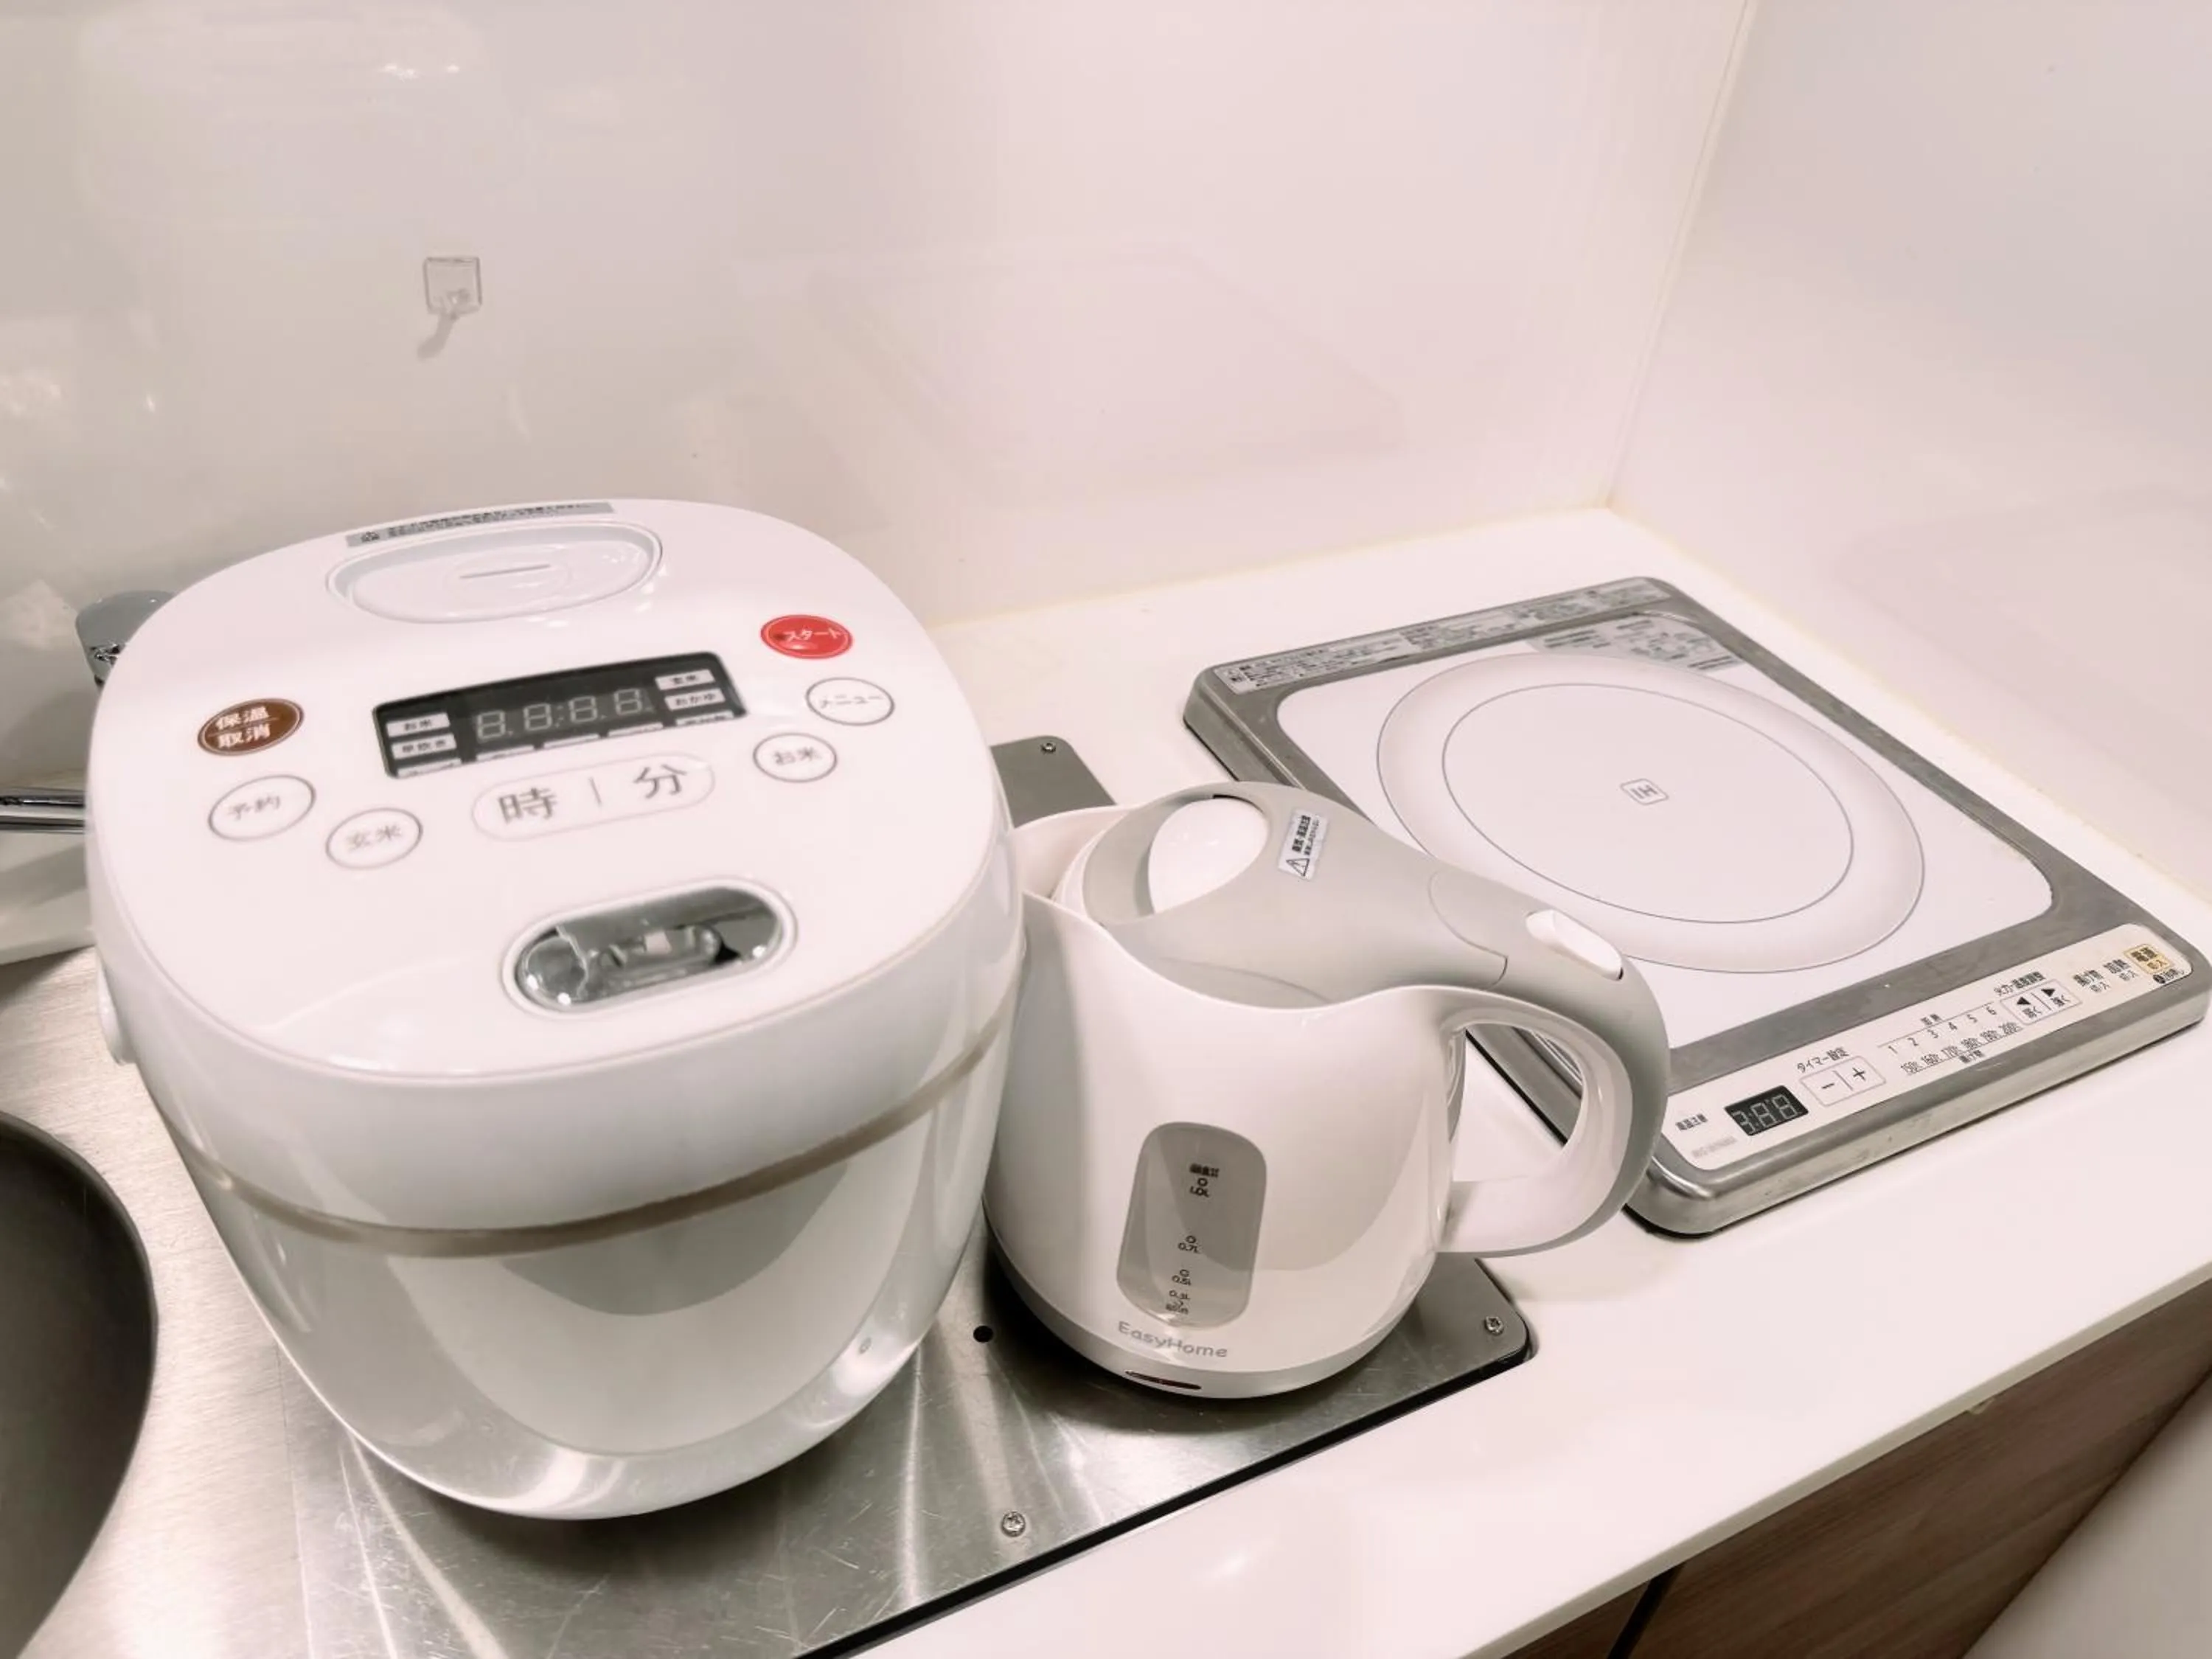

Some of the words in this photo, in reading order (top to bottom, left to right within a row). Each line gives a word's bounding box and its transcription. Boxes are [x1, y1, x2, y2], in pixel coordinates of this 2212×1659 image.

[783, 627, 842, 641] スタート
[818, 694, 883, 709] メニュー
[215, 706, 270, 731] 保温
[218, 723, 271, 749] 取消
[497, 787, 557, 824] 時
[633, 763, 687, 799] 分
[1907, 1037, 1919, 1047] 2
[1118, 1321, 1228, 1358] EasyHome
